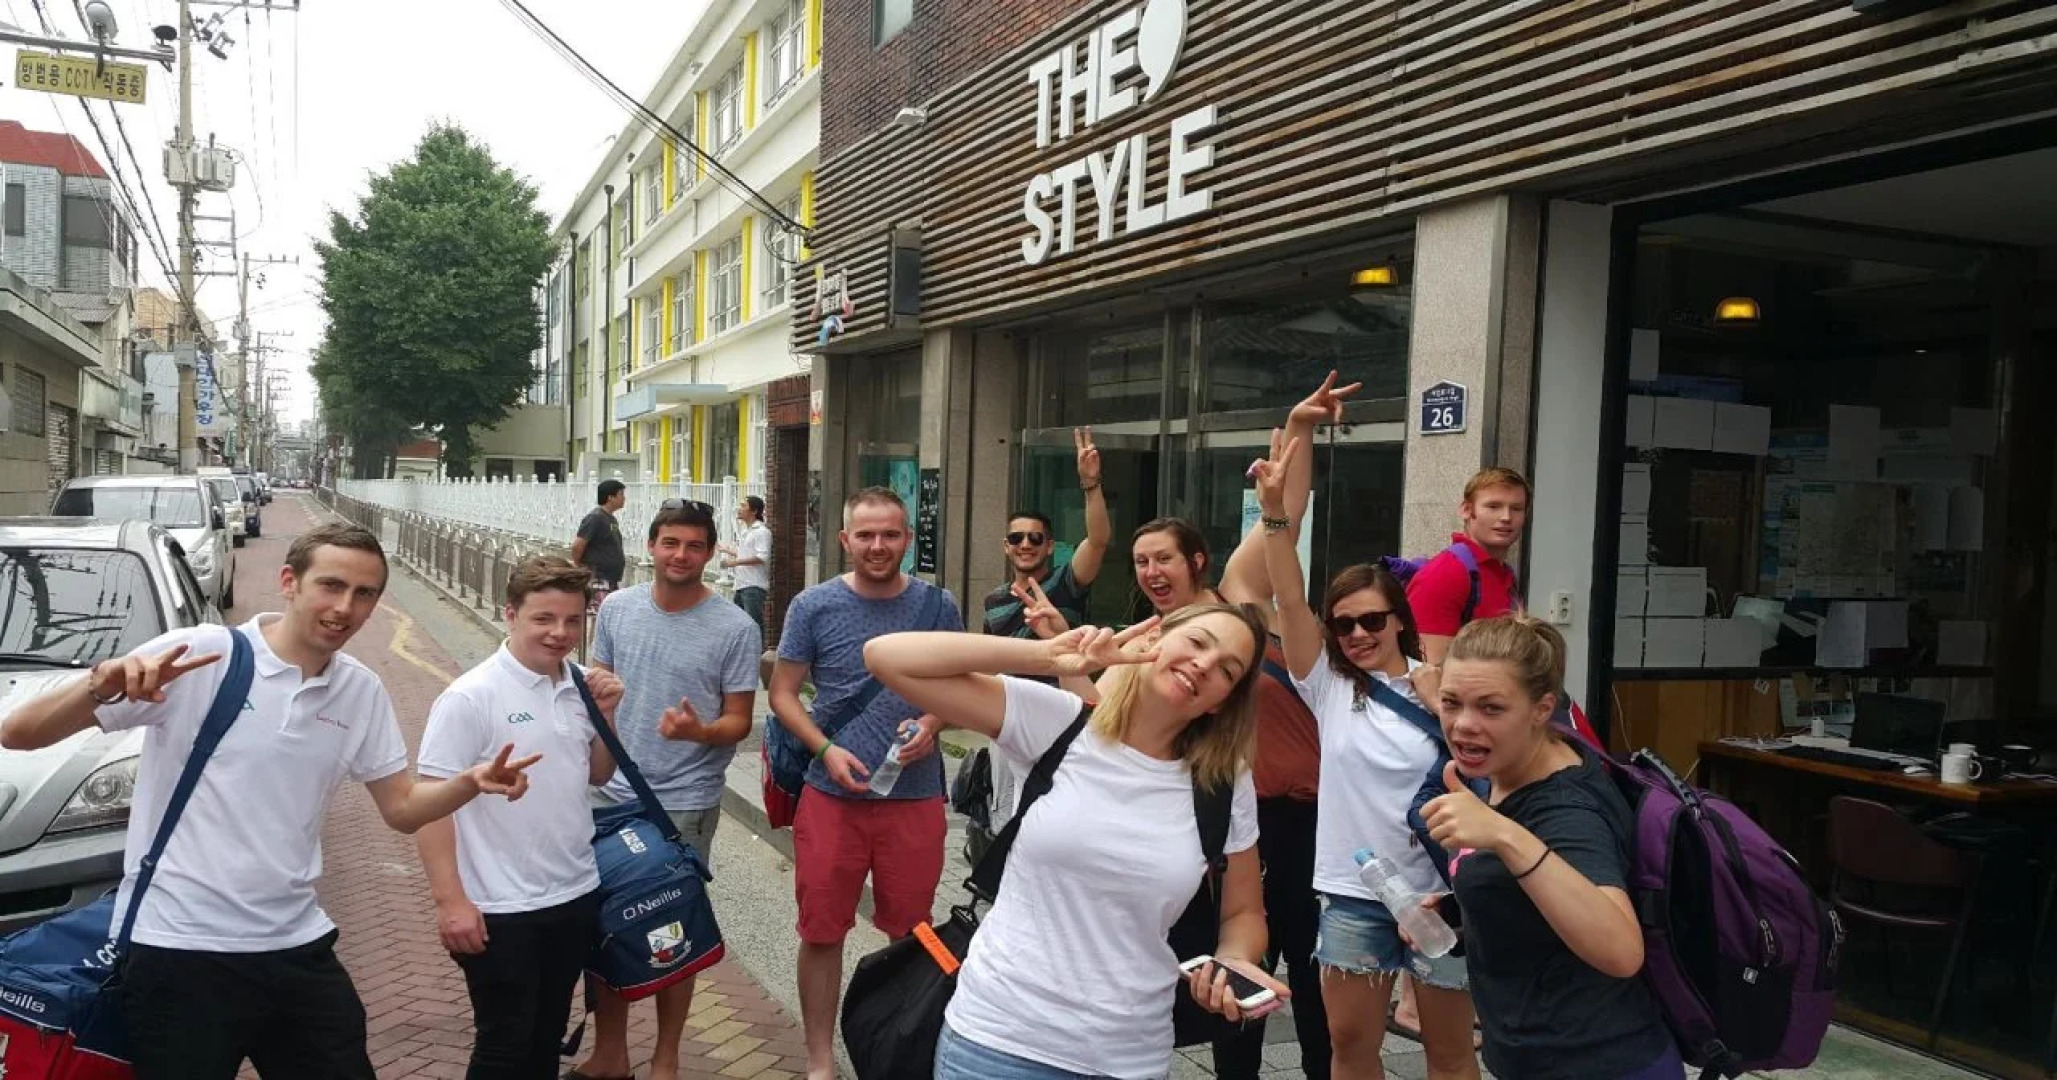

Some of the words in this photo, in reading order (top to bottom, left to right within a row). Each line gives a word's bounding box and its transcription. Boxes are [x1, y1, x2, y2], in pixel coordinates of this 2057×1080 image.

[65, 66, 100, 91] CCTV
[1029, 6, 1142, 149] THE
[1022, 104, 1217, 265] STYLE
[1431, 407, 1454, 427] 26
[0, 986, 46, 1013] eills
